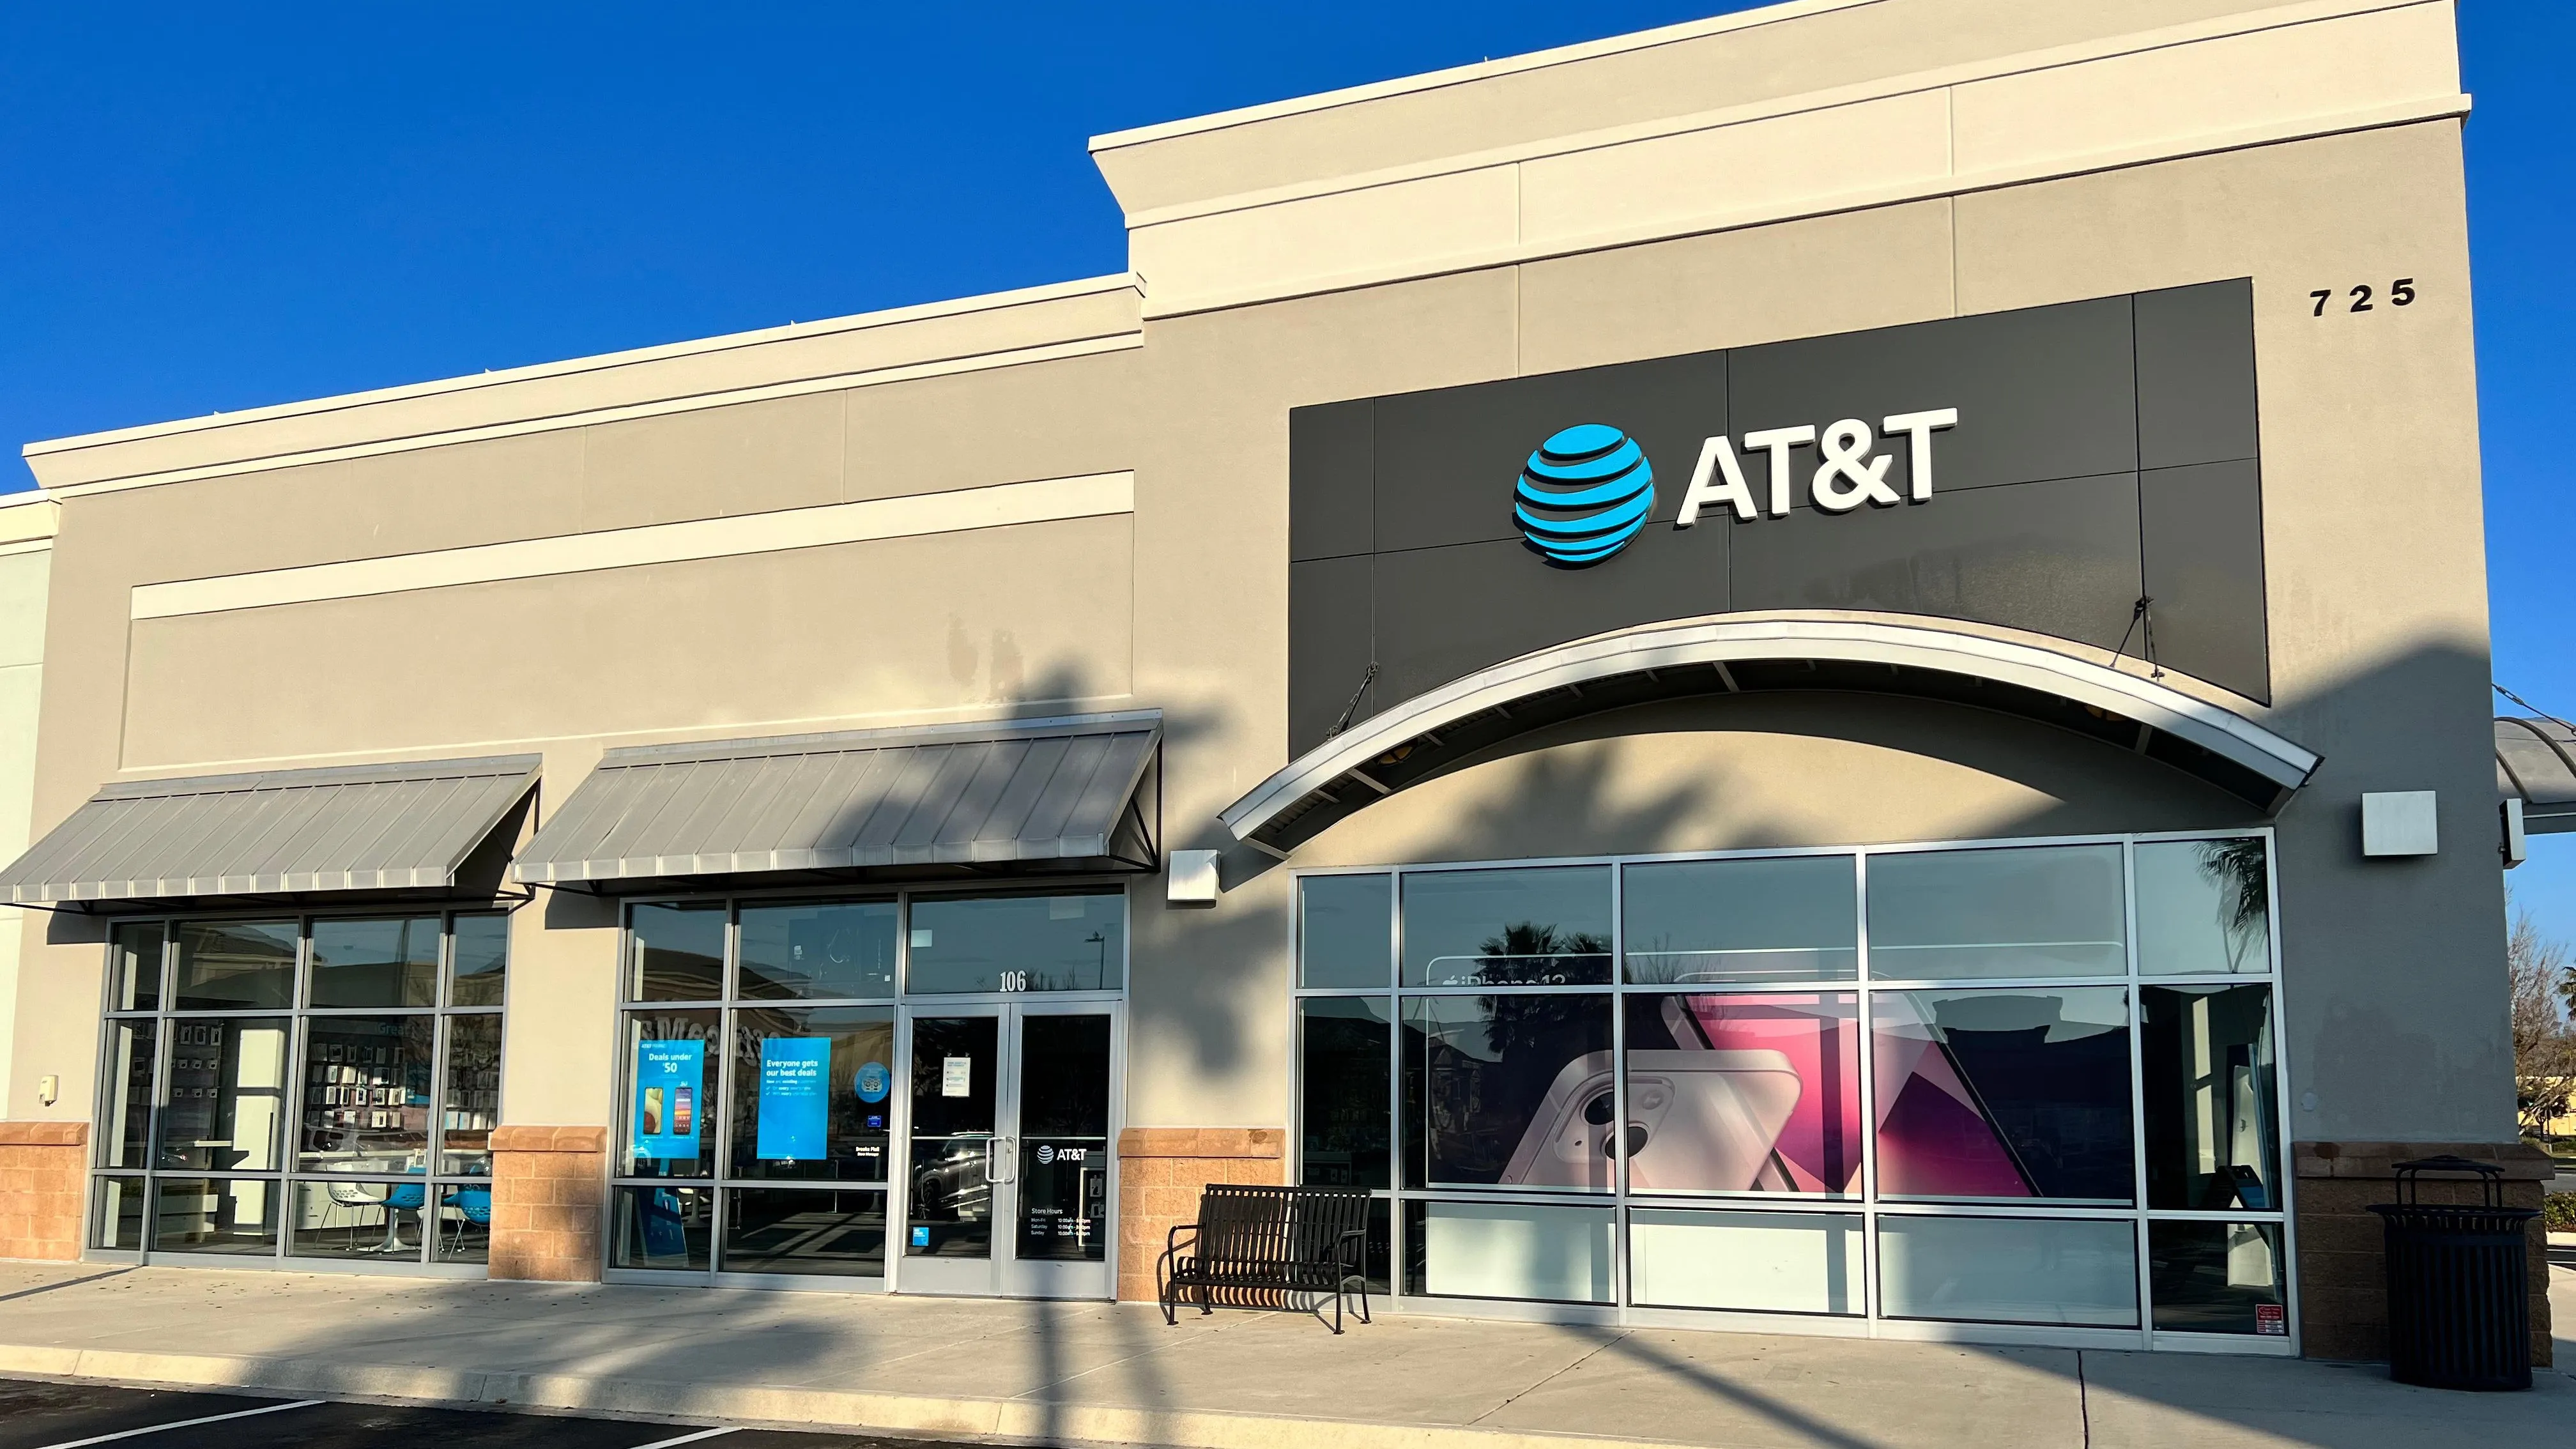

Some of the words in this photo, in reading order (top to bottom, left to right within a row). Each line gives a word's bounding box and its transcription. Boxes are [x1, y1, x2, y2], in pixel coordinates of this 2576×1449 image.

[2310, 278, 2415, 316] 725
[1676, 407, 1958, 526] AT&T
[1000, 970, 1026, 992] 106
[767, 1059, 801, 1068] Everyone
[801, 1060, 818, 1068] gets
[1057, 1148, 1087, 1161] AT&T
